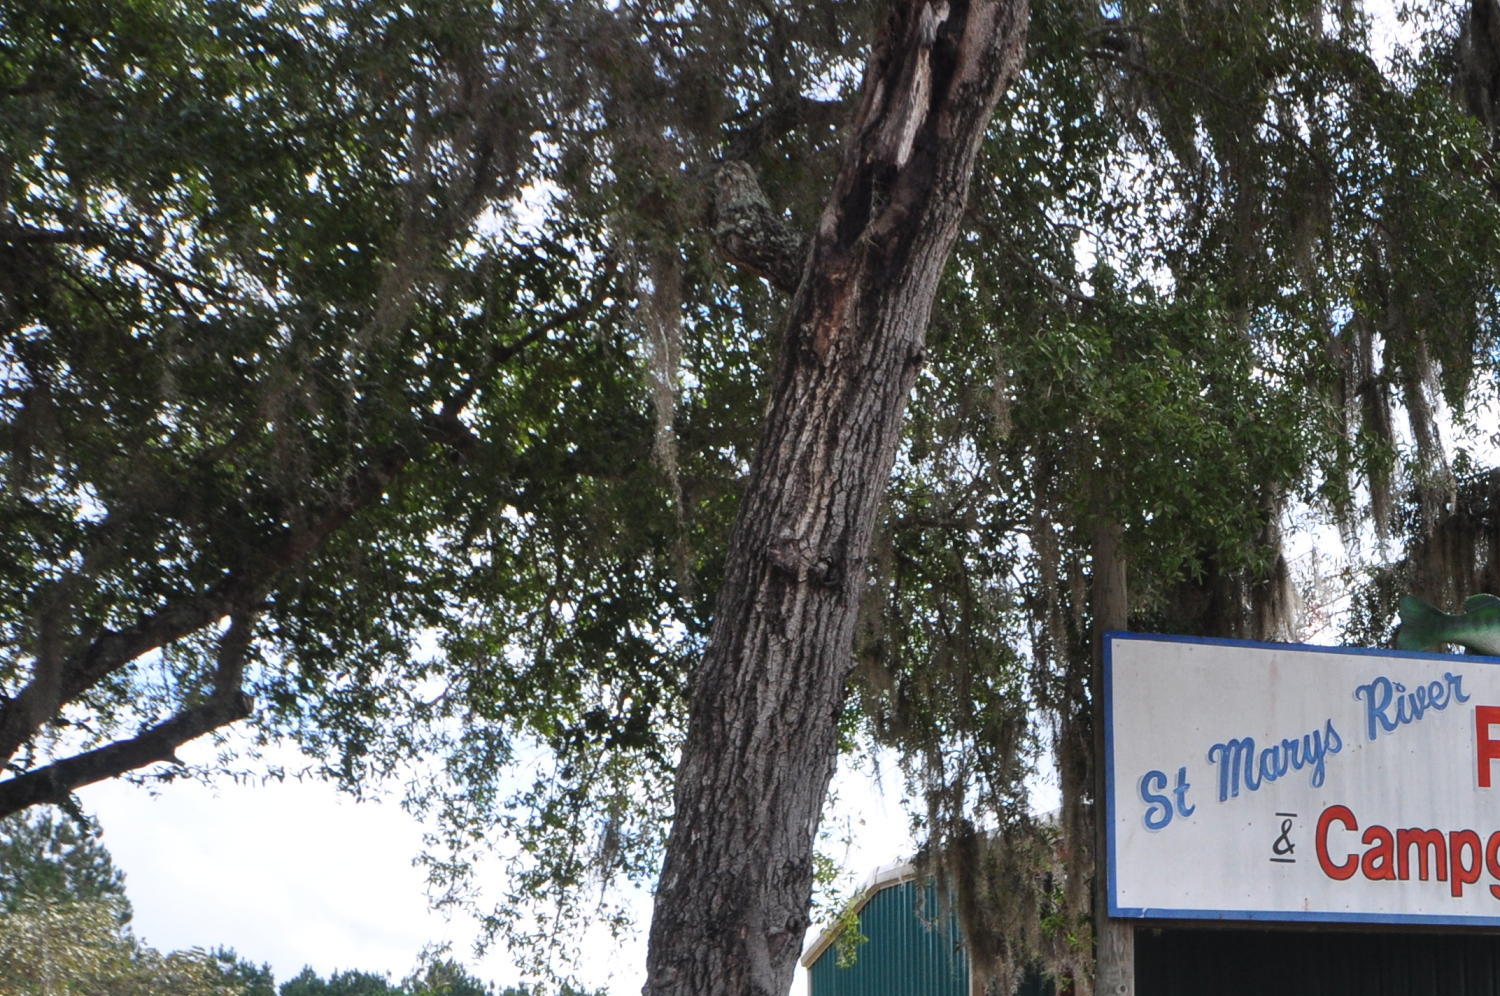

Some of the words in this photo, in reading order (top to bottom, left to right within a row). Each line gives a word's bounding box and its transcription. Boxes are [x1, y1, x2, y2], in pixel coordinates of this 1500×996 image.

[1140, 767, 1196, 831] St
[1208, 718, 1343, 802] Marys
[1355, 672, 1471, 741] River
[1270, 814, 1297, 860] &
